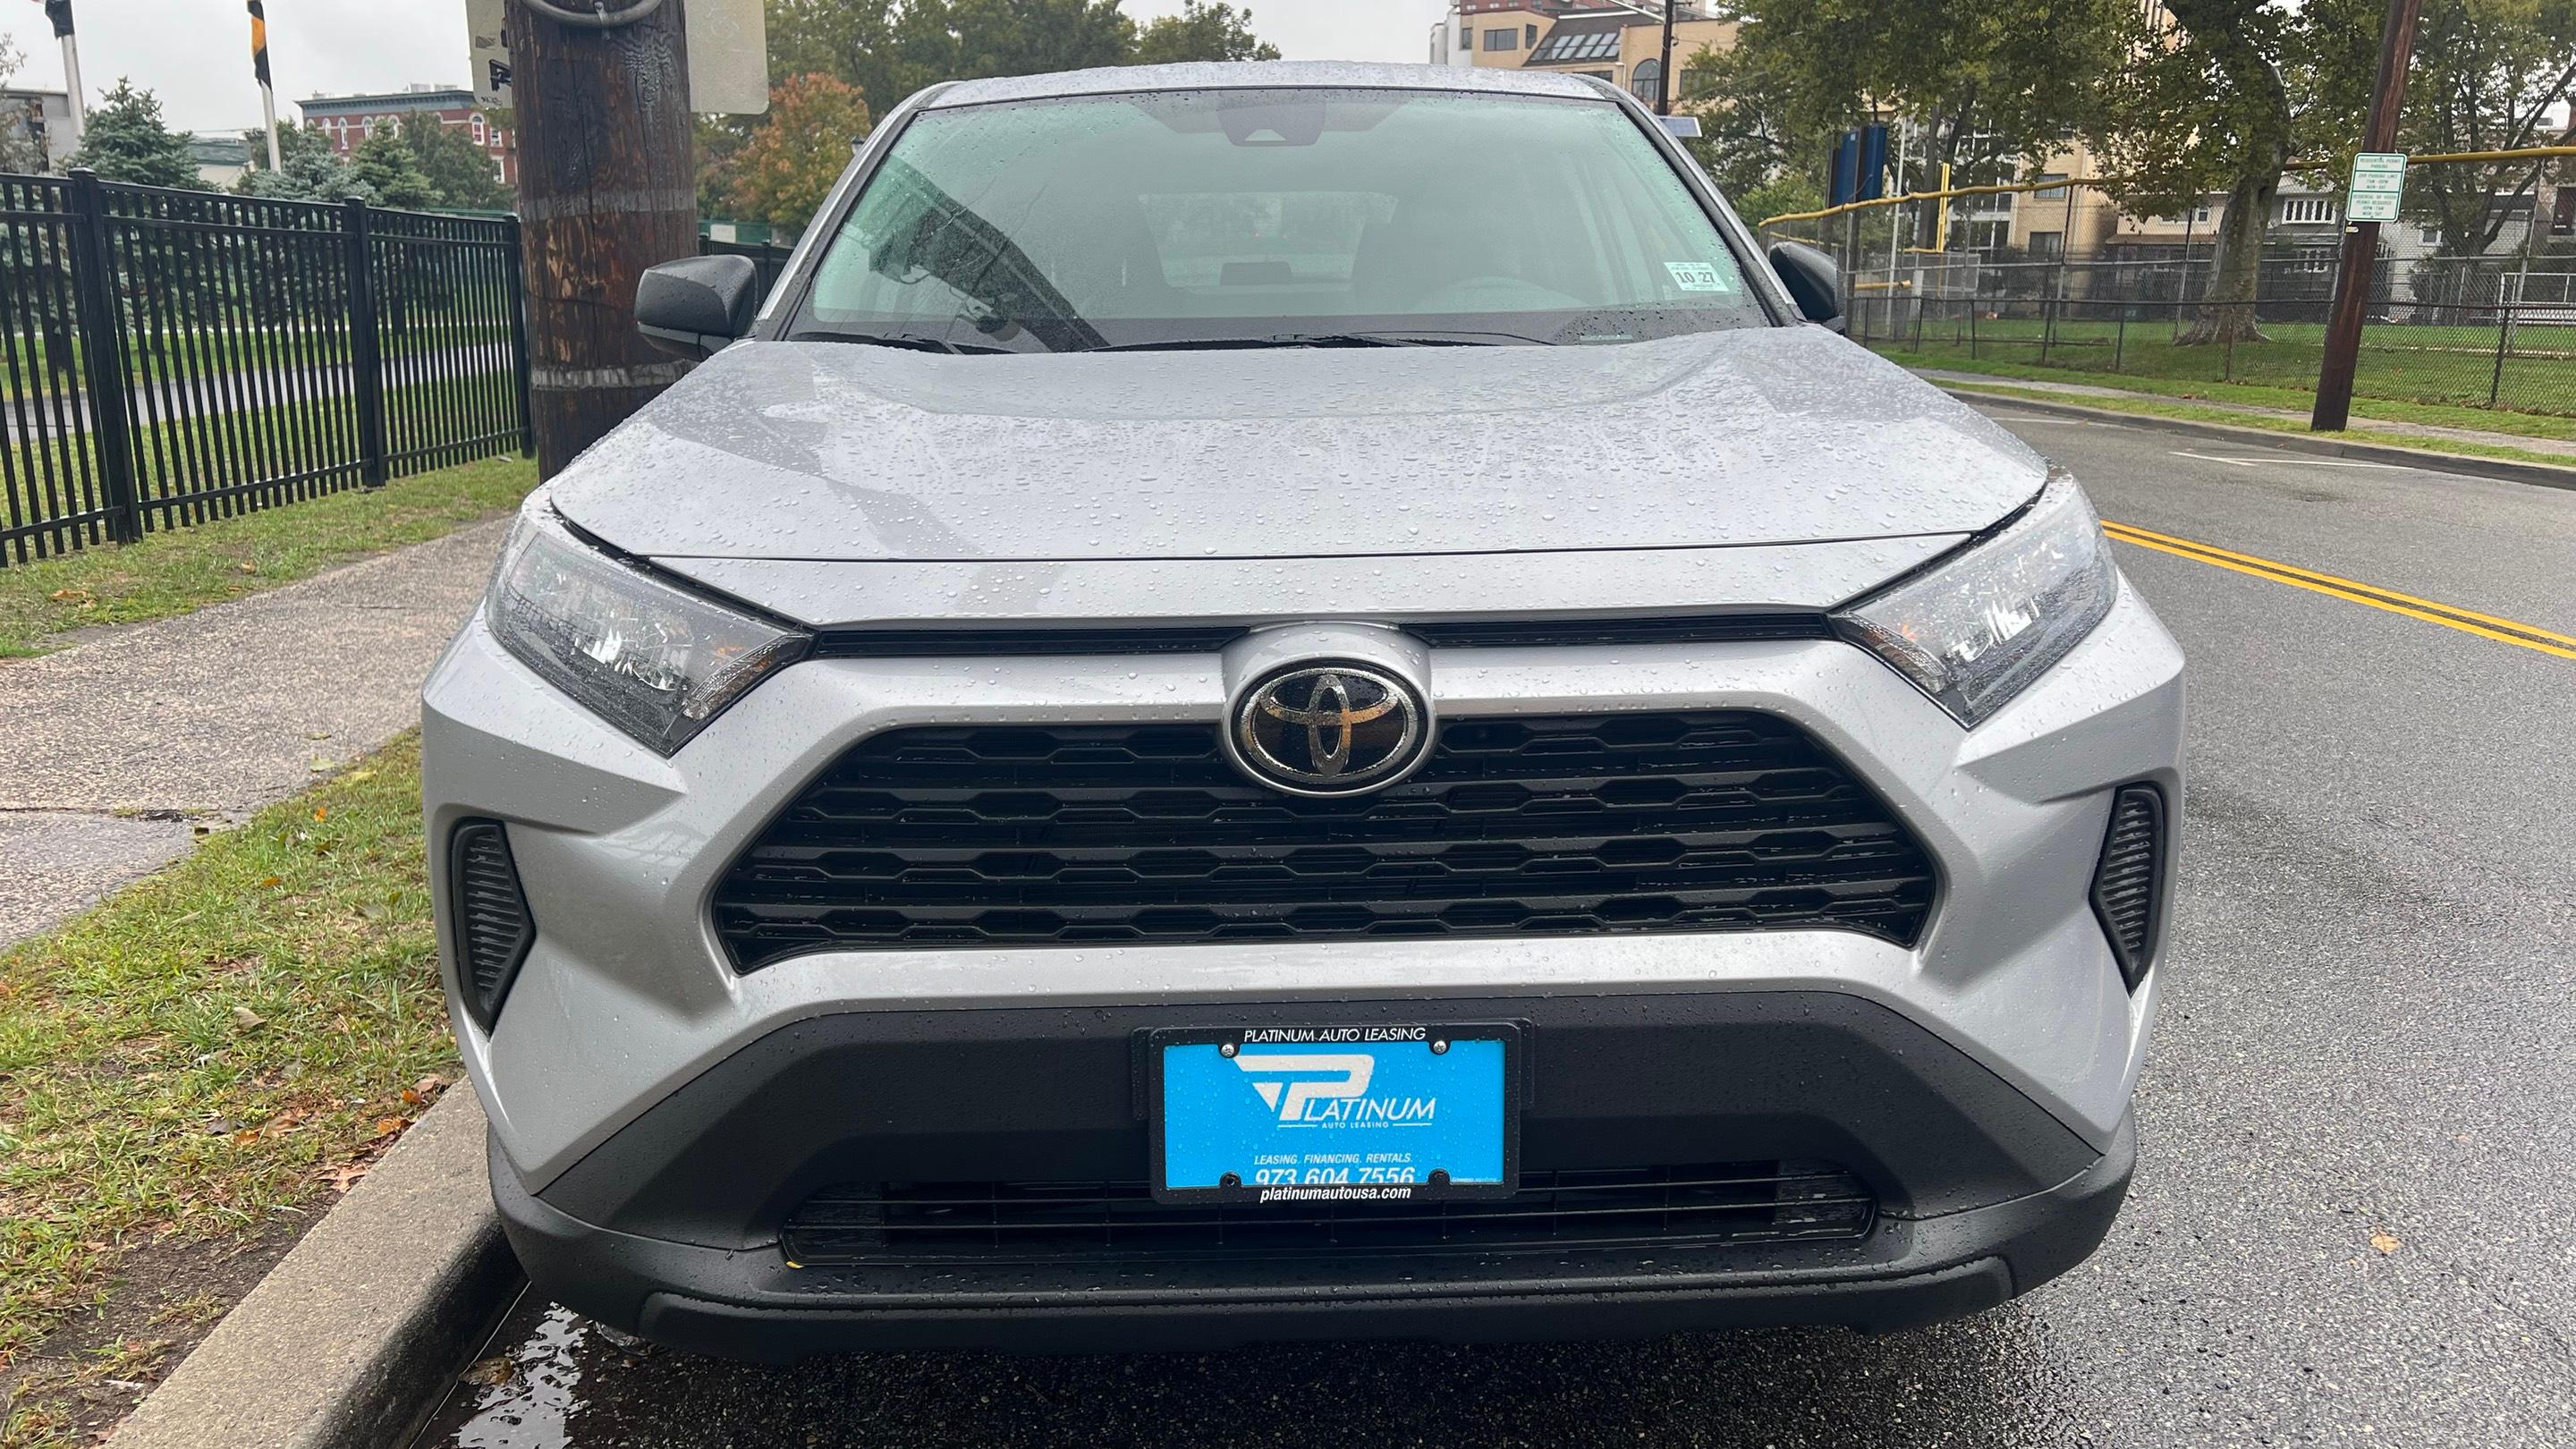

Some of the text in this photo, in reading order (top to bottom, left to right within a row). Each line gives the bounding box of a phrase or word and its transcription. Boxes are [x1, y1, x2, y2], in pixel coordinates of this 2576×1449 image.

[1675, 271, 1716, 283] 10 27
[1244, 1028, 1426, 1042] PLATINUM AUTO LEASING
[1233, 1054, 1436, 1122] PLATINUM
[1303, 1154, 1361, 1164] FINANCING.
[1255, 1166, 1415, 1185] 973 604 7556
[1259, 1187, 1412, 1204] platinumautousa.com
